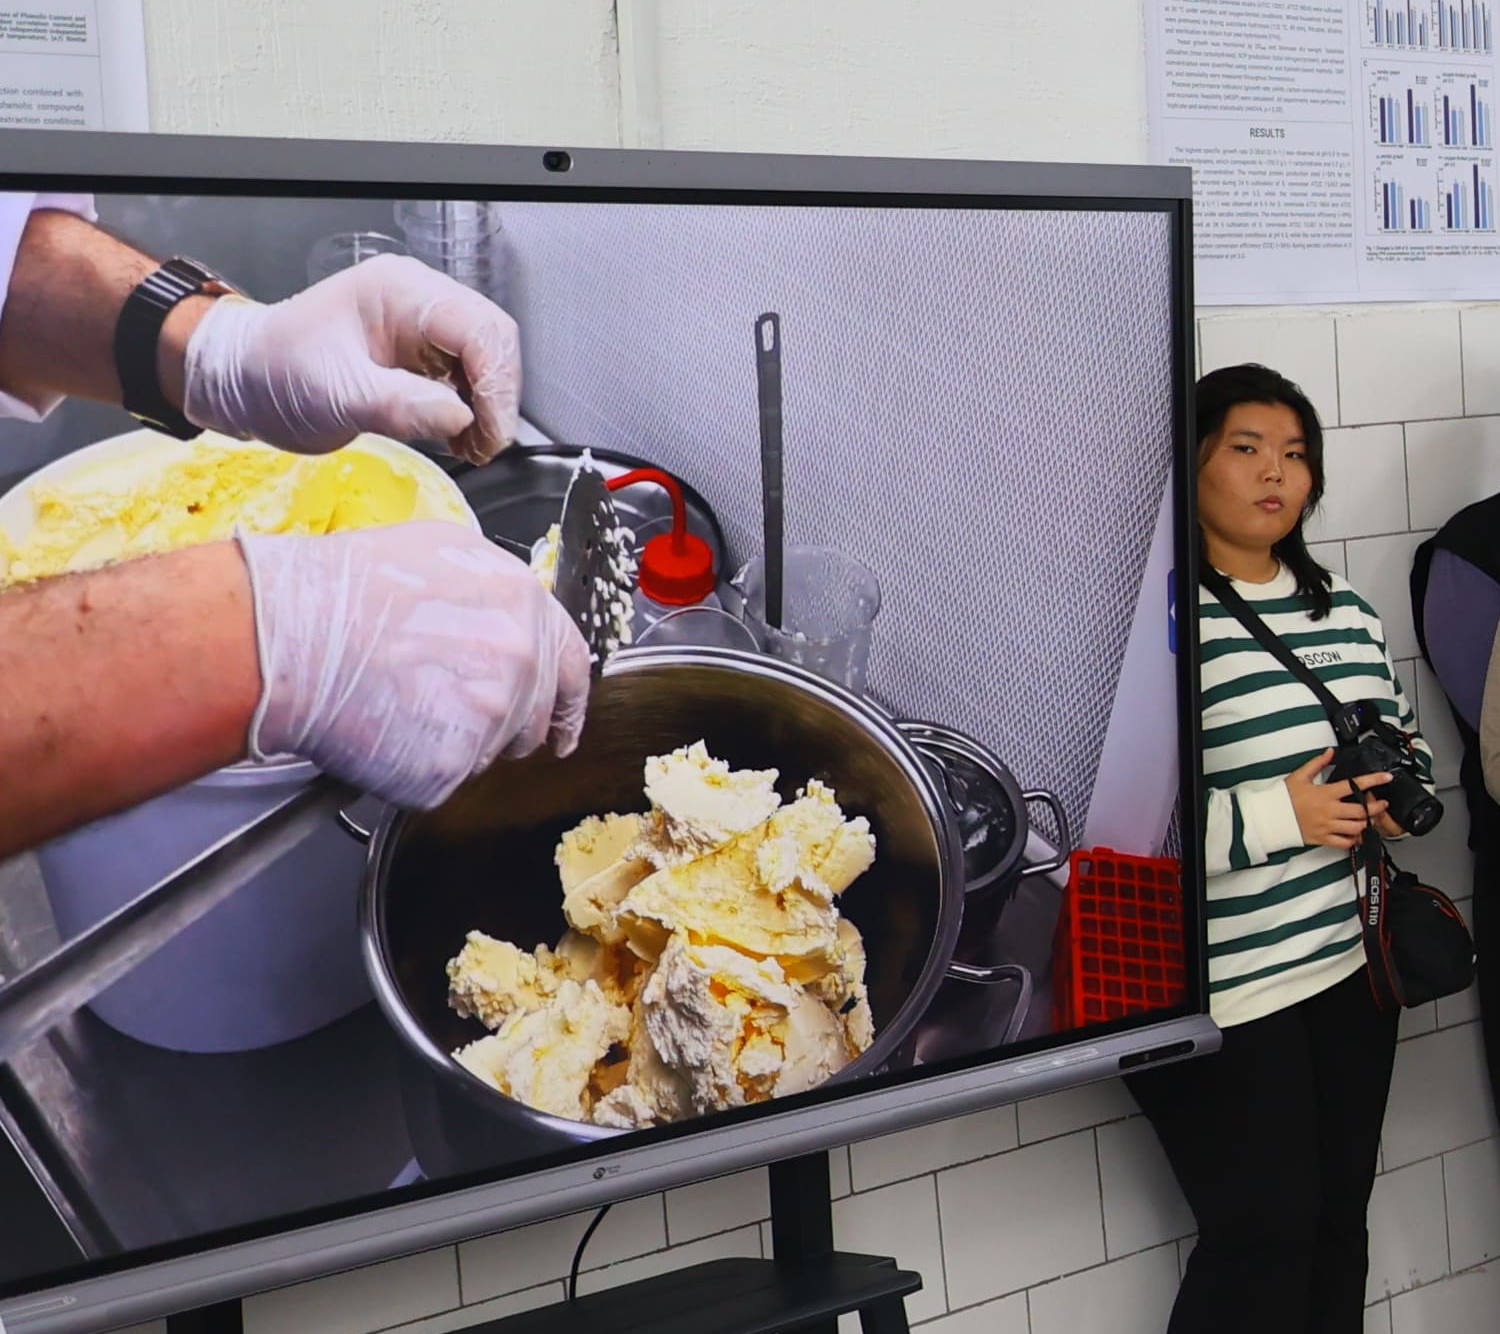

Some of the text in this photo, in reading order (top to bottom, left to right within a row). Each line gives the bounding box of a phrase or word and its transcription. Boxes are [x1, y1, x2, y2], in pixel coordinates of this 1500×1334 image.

[1249, 127, 1286, 139] RESULTS
[1298, 650, 1343, 666] OSCOW
[1370, 875, 1380, 905] EOS
